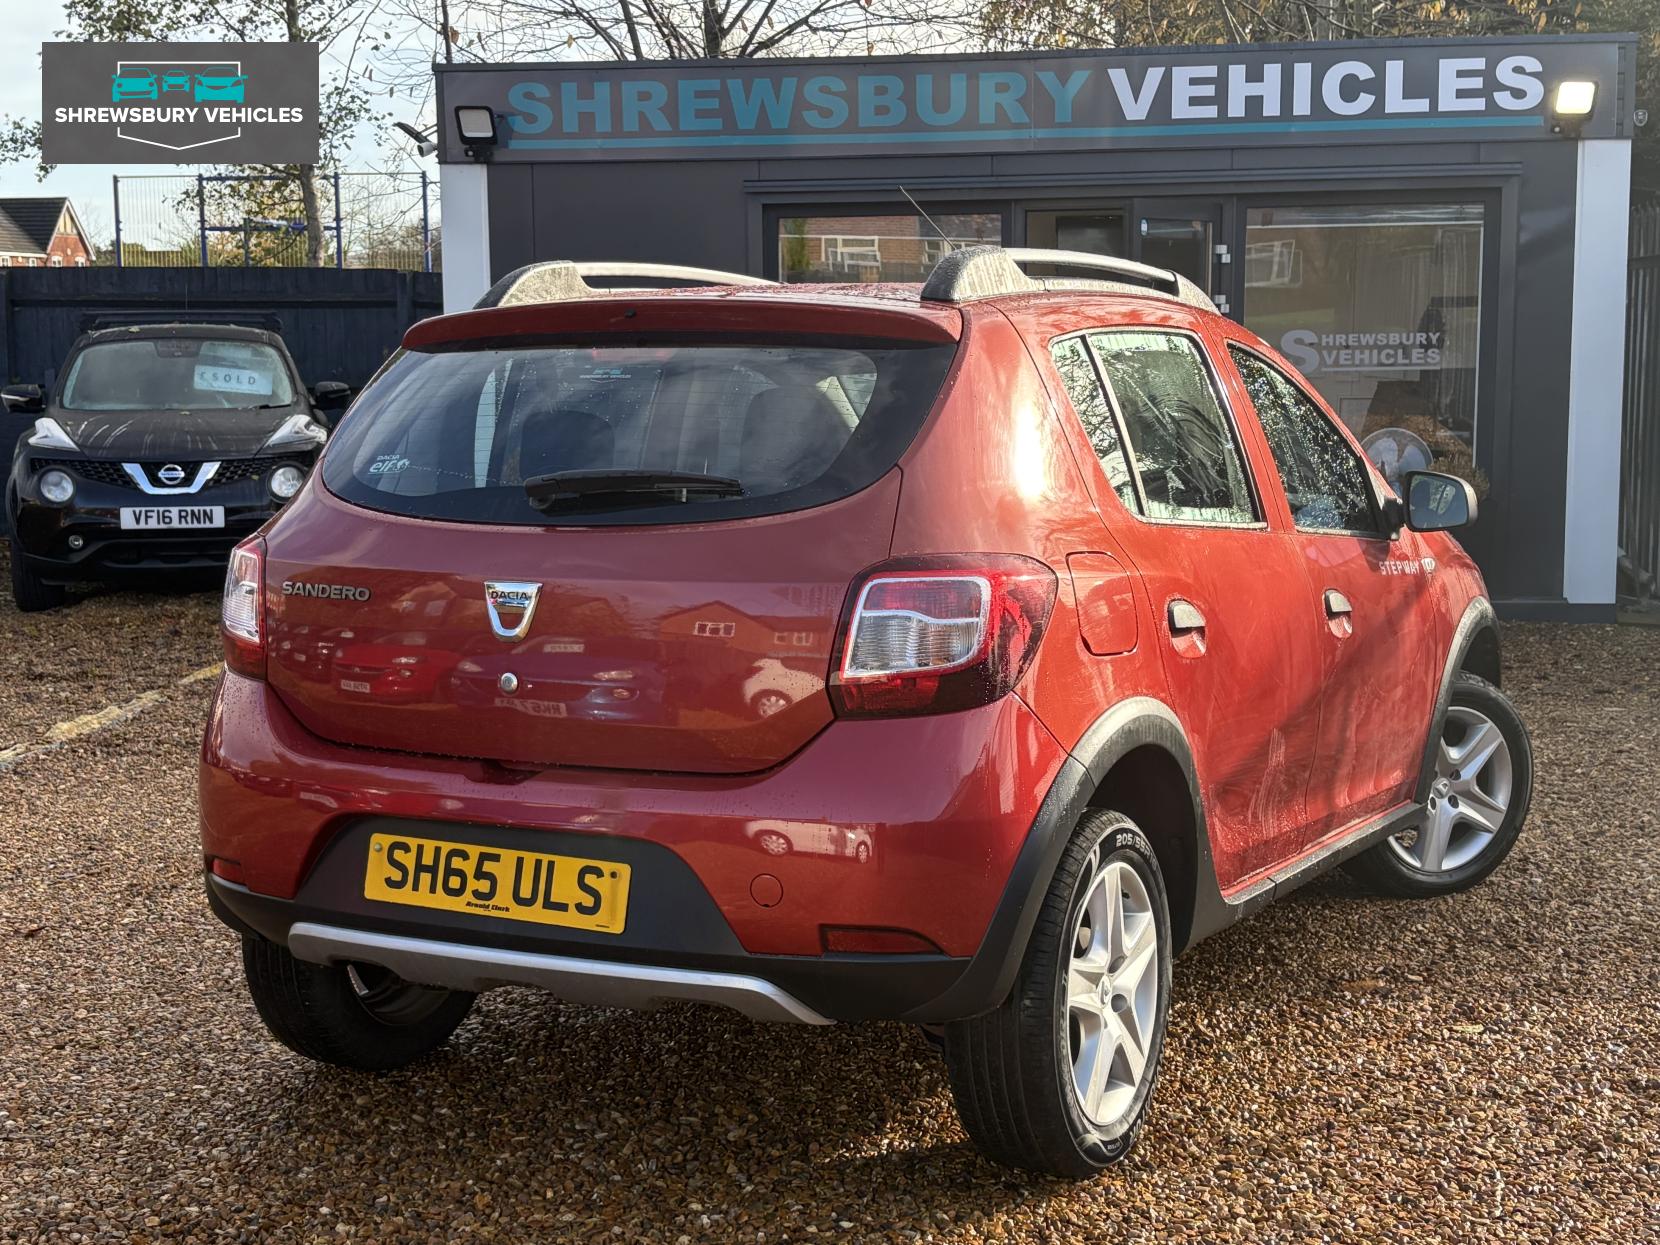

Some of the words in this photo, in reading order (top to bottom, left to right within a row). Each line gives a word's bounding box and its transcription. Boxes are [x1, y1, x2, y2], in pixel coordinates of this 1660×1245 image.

[507, 70, 1091, 134] SHREWSBURY
[1107, 55, 1545, 120] VEHICLES
[1281, 329, 1440, 374] SHREWSBURY
[1321, 349, 1441, 366] VEHICLES
[212, 372, 256, 385] SOLD
[132, 509, 173, 526] VF16
[178, 508, 214, 525] RNN
[1378, 559, 1421, 577] STEPWAY
[281, 580, 371, 602] SANDERO
[490, 590, 529, 601] DACIA
[384, 841, 502, 902] SH65
[512, 856, 605, 916] ULS
